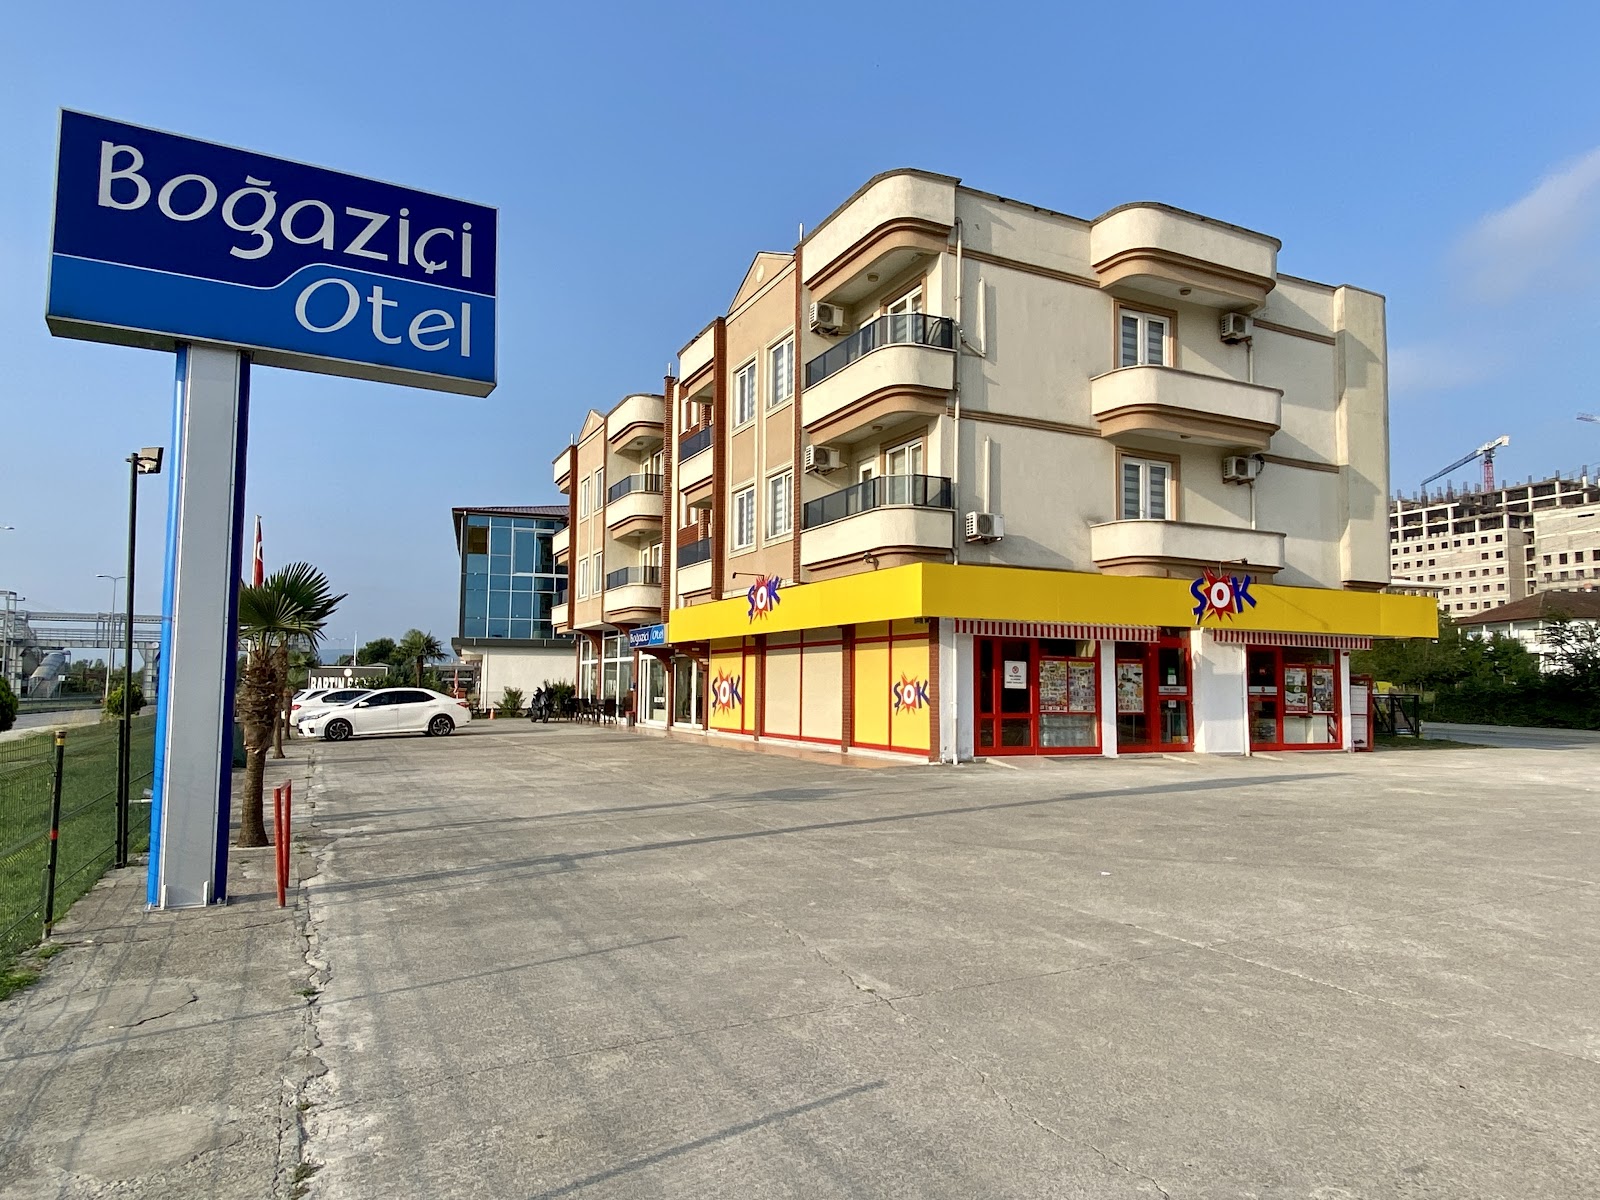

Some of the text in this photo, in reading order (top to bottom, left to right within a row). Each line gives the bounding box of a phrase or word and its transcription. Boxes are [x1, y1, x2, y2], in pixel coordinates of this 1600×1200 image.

[98, 140, 472, 278] Boğaziçi
[294, 277, 471, 358] Otel
[748, 575, 781, 625] ŞOK
[1189, 574, 1257, 625] ŞOK
[652, 629, 664, 640] Otel
[712, 675, 742, 717] ŞOK
[893, 679, 930, 716] ŞOK
